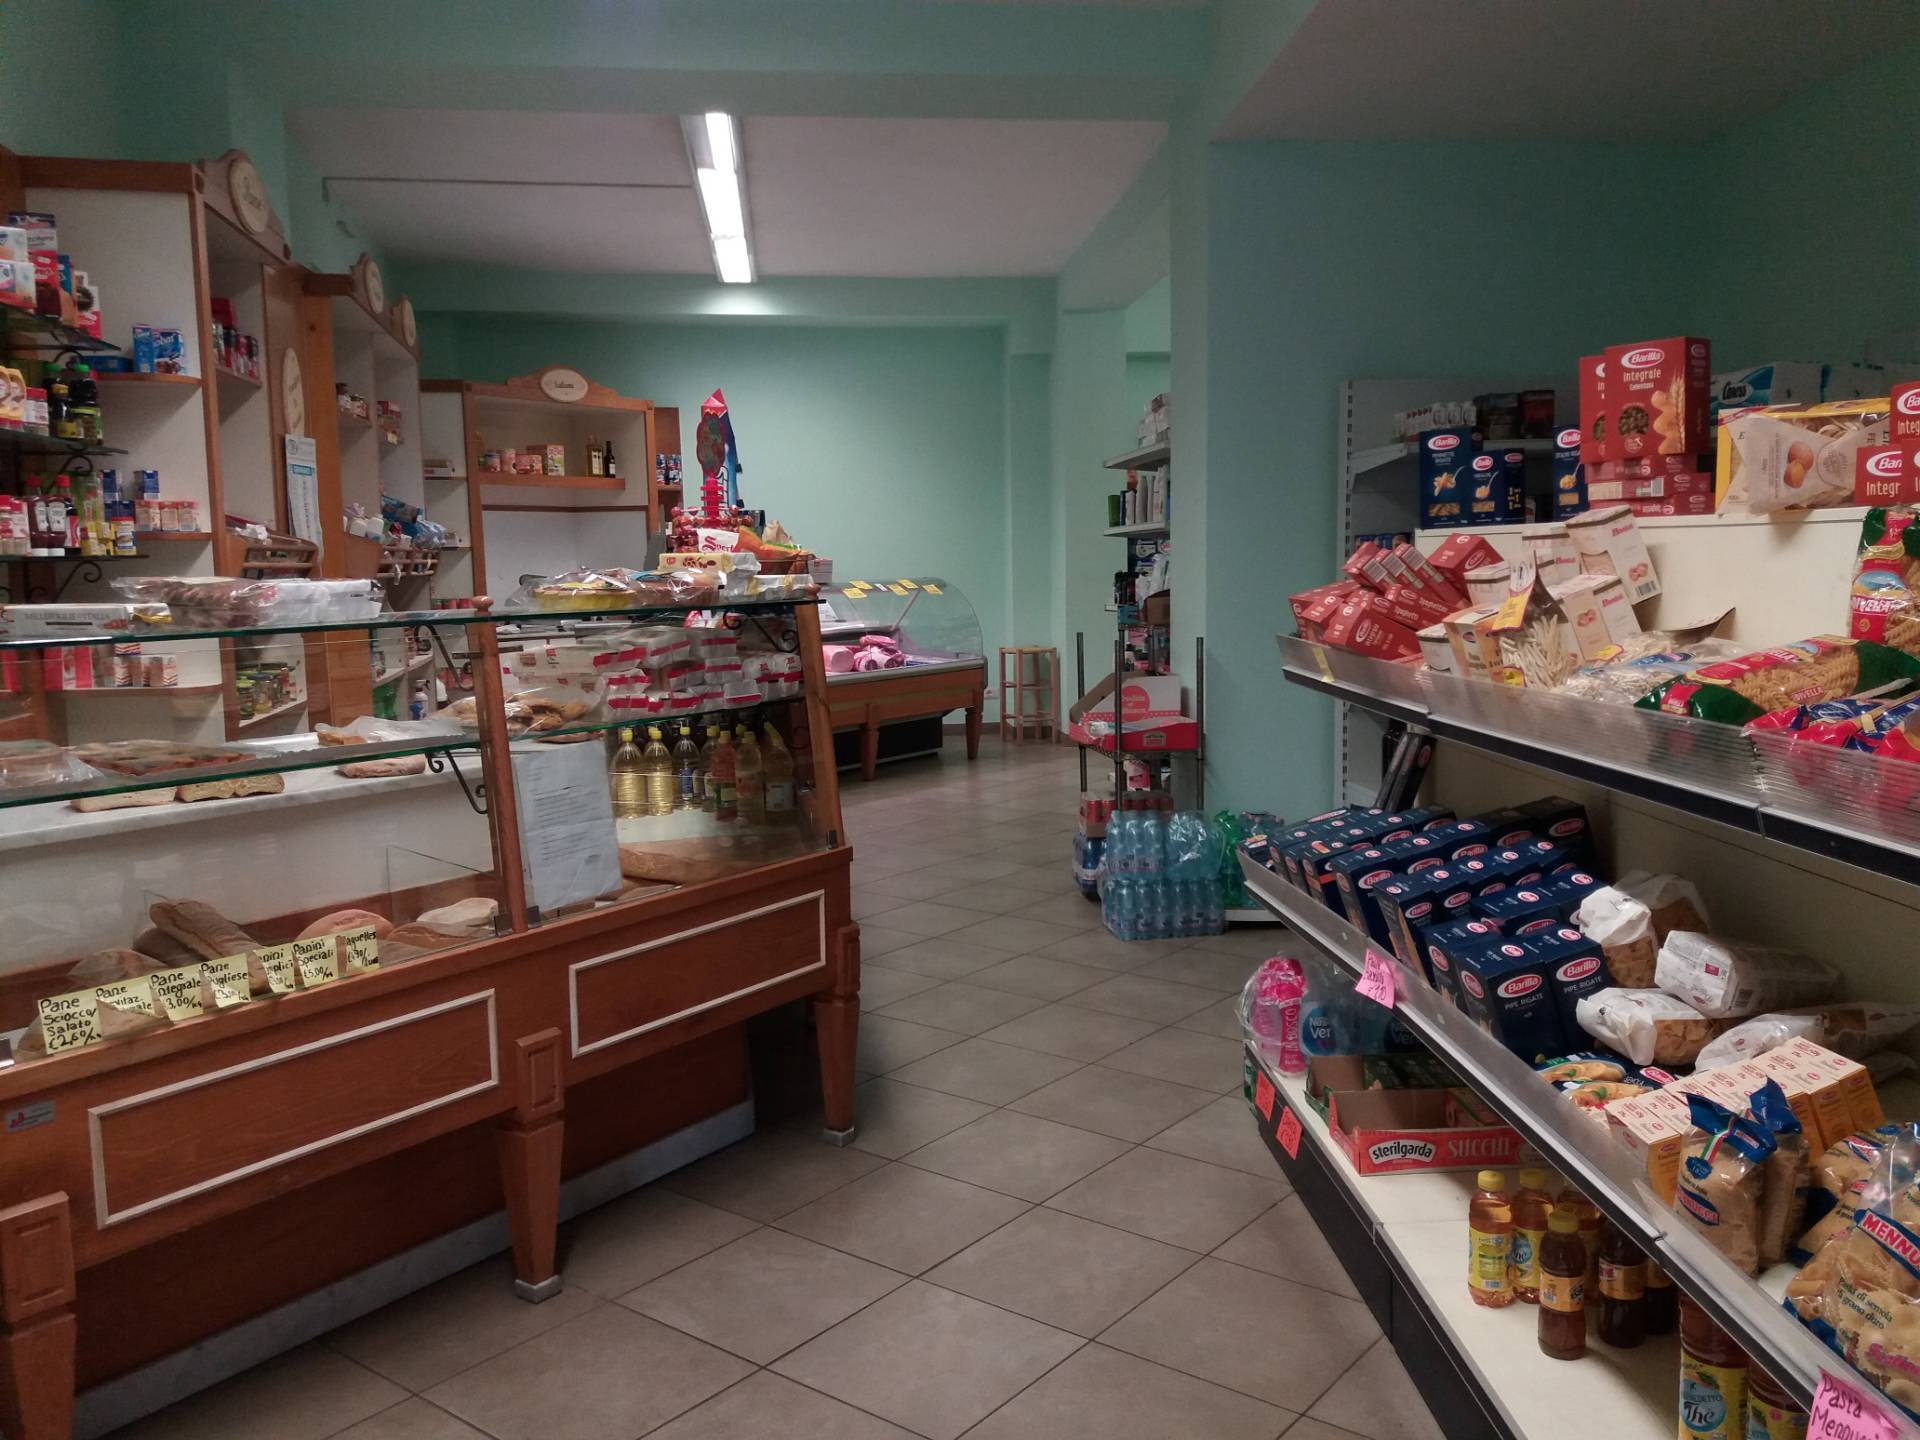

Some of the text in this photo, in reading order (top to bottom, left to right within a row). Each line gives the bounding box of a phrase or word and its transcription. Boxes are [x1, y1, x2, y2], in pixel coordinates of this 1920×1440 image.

[1630, 351, 1662, 364] Barilla
[1623, 368, 1662, 383] Integrale
[1567, 959, 1599, 977] Barilla
[151, 972, 184, 986] Pane
[1508, 976, 1541, 994] Barilla
[96, 985, 128, 999] Pane
[40, 996, 80, 1014] Pane
[1504, 993, 1544, 1010] PIPE RIGATE
[47, 1019, 92, 1037] Salato
[1372, 1137, 1512, 1160] sterilgarda SUCCHI
[1841, 1296, 1866, 1315] grano
[1865, 1312, 1885, 1330] duro
[1856, 1292, 1868, 1301] di
[1865, 1299, 1893, 1323] semola
[1819, 1373, 1862, 1419] Pasta
